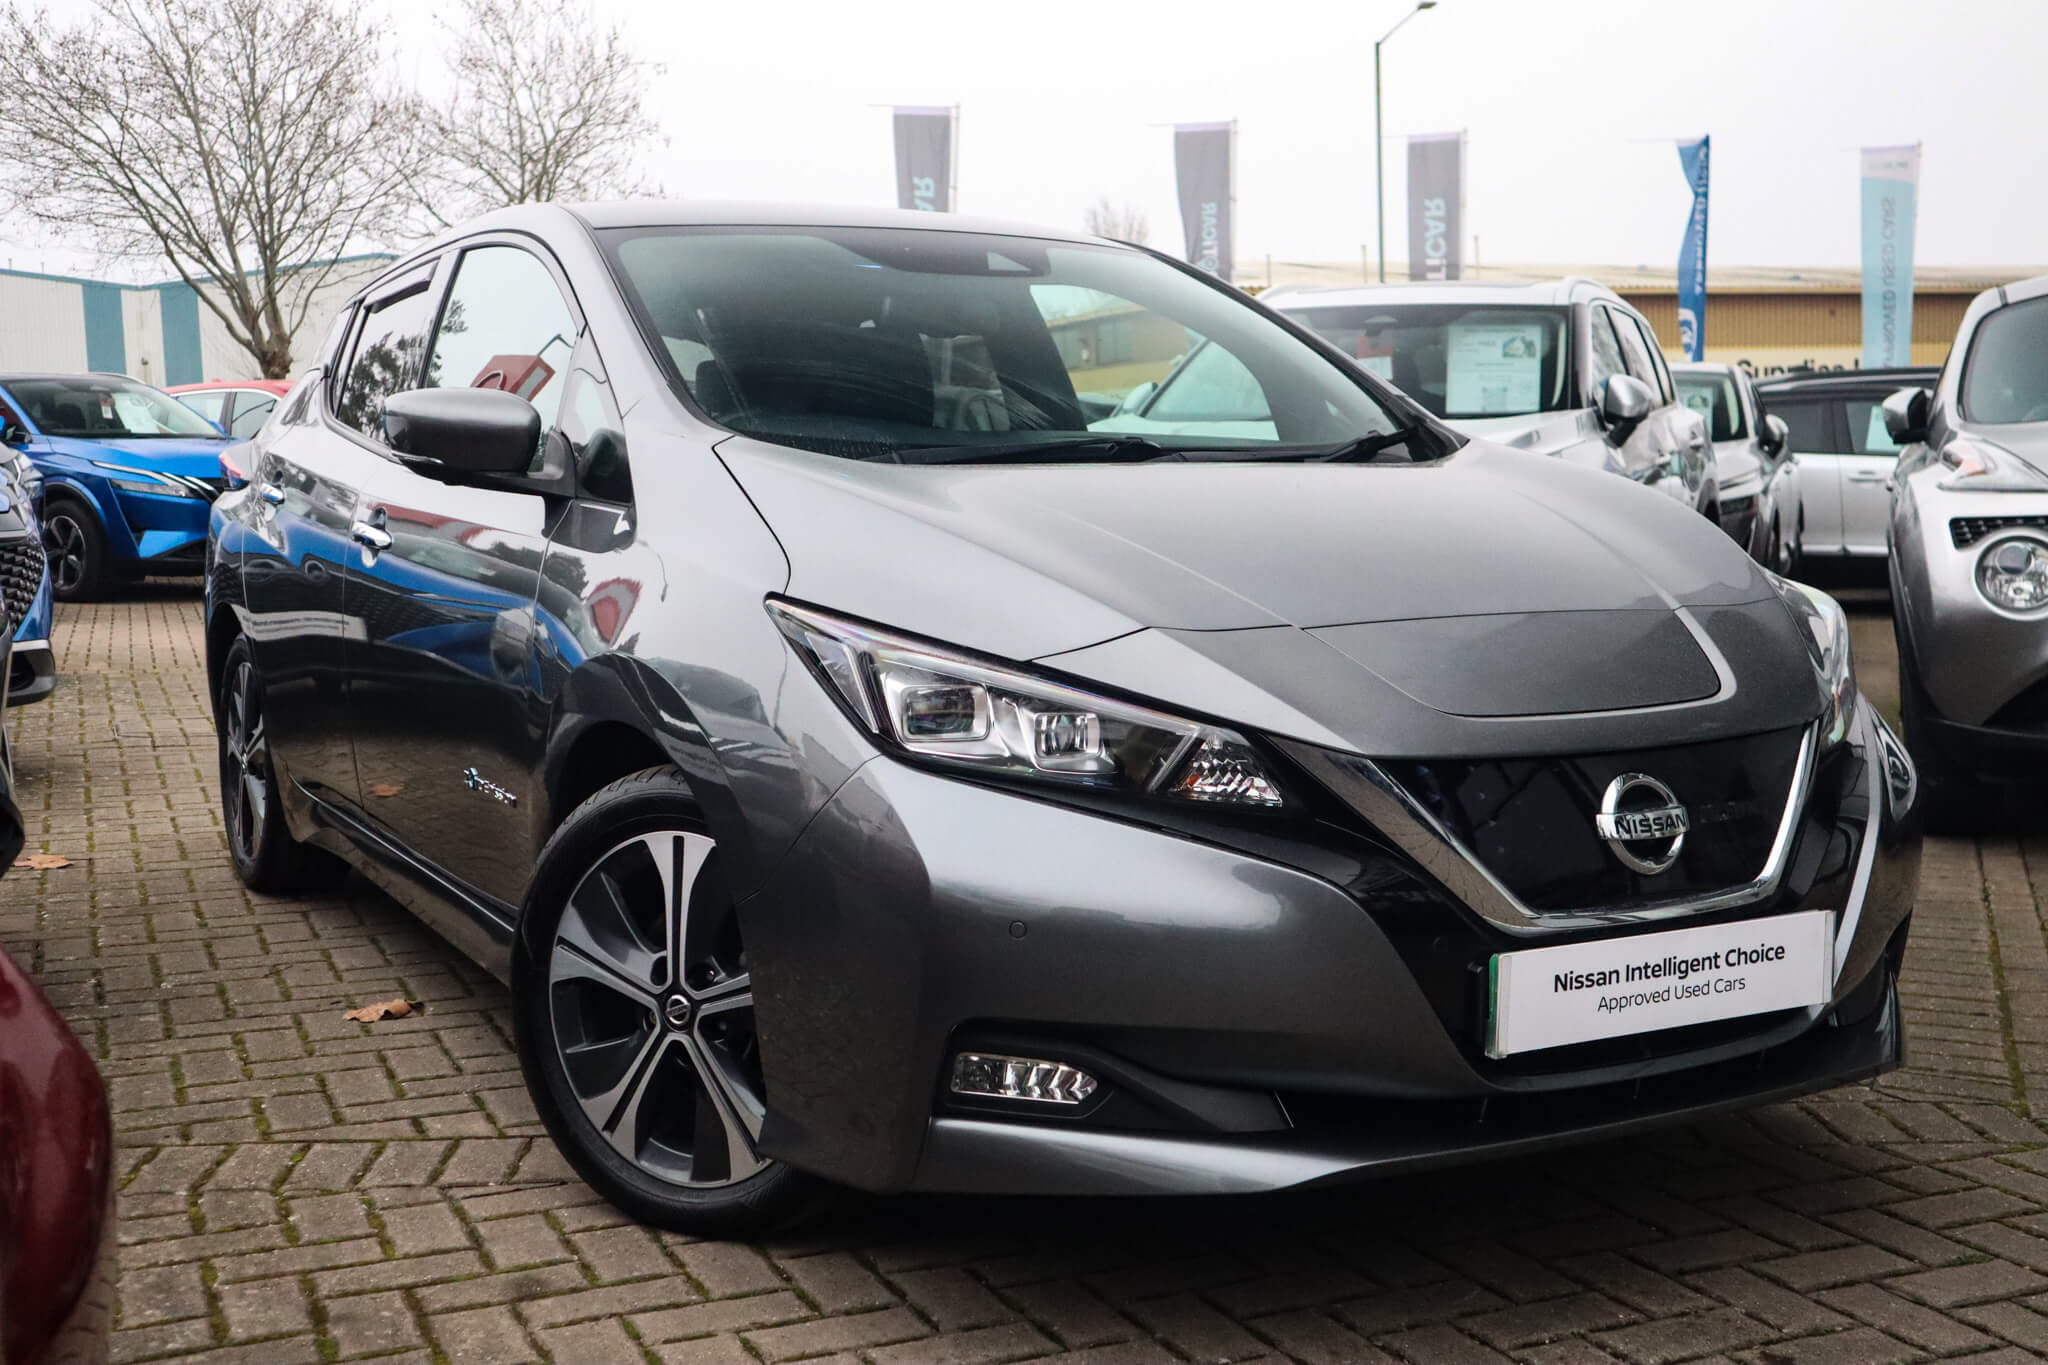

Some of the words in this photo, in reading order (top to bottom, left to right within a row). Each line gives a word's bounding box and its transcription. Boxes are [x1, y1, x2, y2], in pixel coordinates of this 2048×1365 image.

[1614, 813, 1687, 836] NISSAN
[1553, 970, 1620, 993] Nissan
[1625, 951, 1721, 980] Intelligent
[1724, 943, 1786, 968] Choice
[1597, 986, 1671, 1014] Approved
[1674, 980, 1710, 1001] Used
[1713, 976, 1746, 994] Cars
